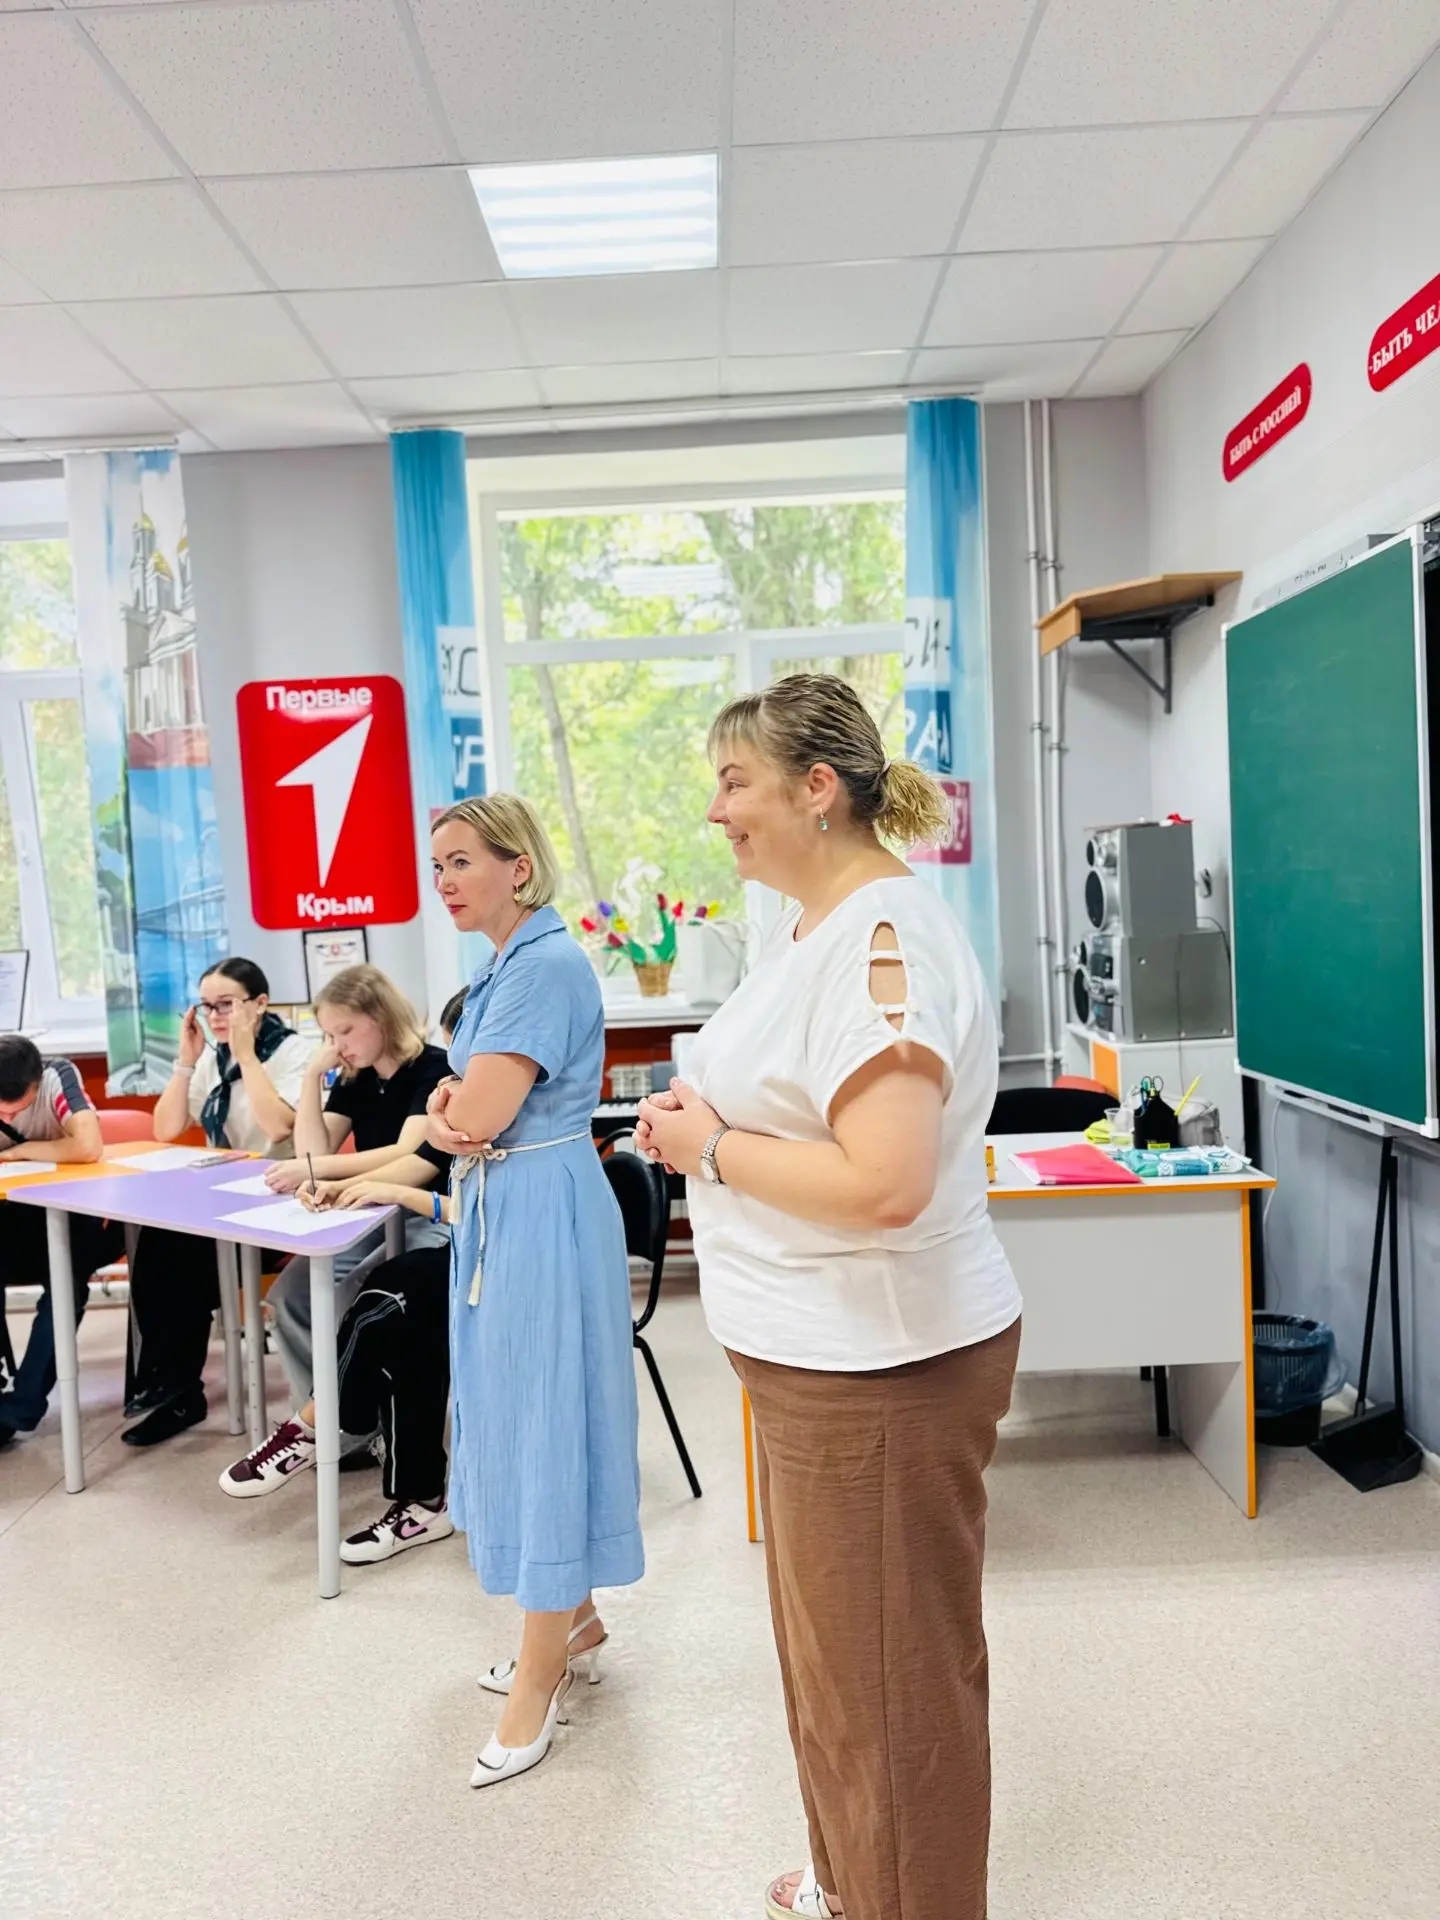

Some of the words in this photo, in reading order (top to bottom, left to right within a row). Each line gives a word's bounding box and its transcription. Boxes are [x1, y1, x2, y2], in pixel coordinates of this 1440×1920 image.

[1372, 328, 1413, 375] БЫТЬ
[1230, 434, 1252, 466] БЫТЬ
[1252, 427, 1259, 445] С
[266, 685, 373, 713] Первые
[297, 892, 374, 921] Крым
